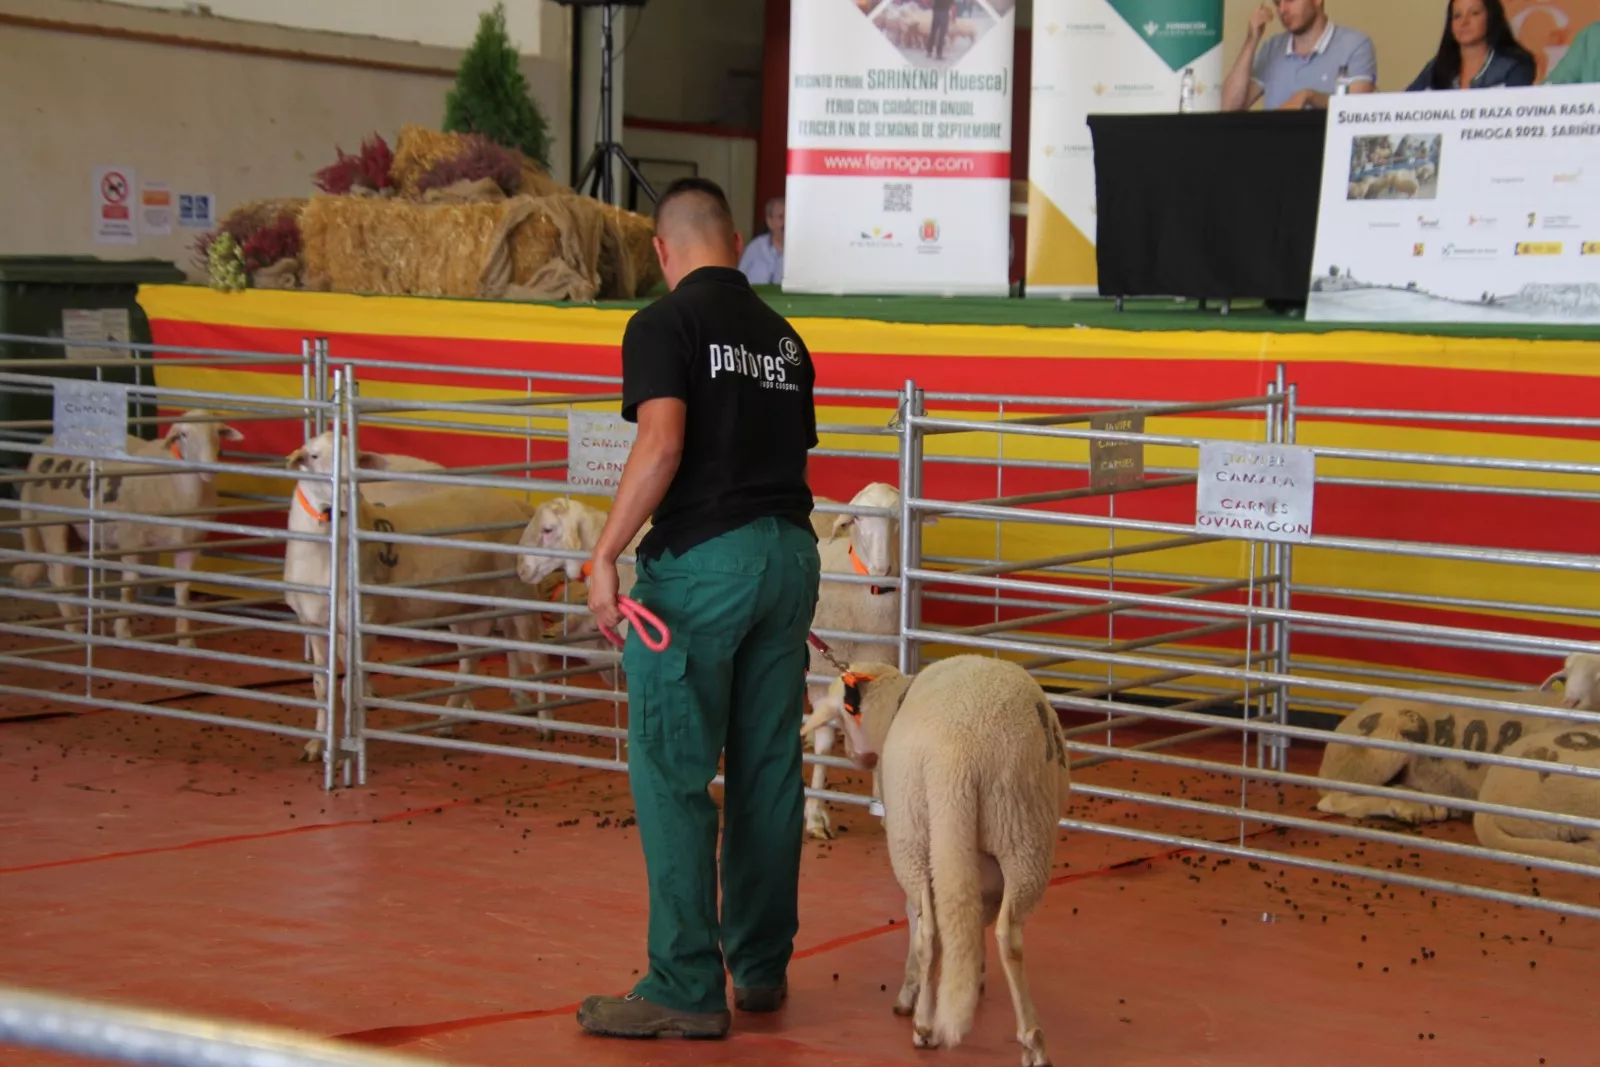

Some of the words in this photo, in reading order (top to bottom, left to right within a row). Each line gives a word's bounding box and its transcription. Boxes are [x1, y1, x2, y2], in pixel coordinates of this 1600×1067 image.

[943, 68, 1008, 96] (Huesca)
[825, 98, 855, 114] FERIA
[857, 99, 879, 115] CON
[882, 98, 937, 116] CARÁCTER
[940, 100, 974, 116] ANUAL
[1395, 108, 1456, 122] NACIONAL
[1460, 107, 1476, 120] DE
[1480, 106, 1512, 119] RAZA
[1516, 104, 1557, 117] OVINA
[1560, 102, 1592, 116] RASA
[799, 120, 836, 136] TERCER
[839, 121, 856, 137] FIN
[858, 121, 872, 137] DE
[875, 121, 919, 138] SEMANA
[922, 122, 936, 138] DE
[938, 122, 1002, 139] SEPTIEMBRE
[1460, 126, 1513, 140] FEMOGA
[823, 153, 974, 174] www.femoga.com
[709, 344, 786, 382] pastores
[581, 437, 630, 448] CAMAR
[586, 461, 623, 472] CARN
[571, 475, 620, 488] OVIARA
[1221, 498, 1288, 514] CARNES
[1198, 515, 1310, 535] OVIARAGON
